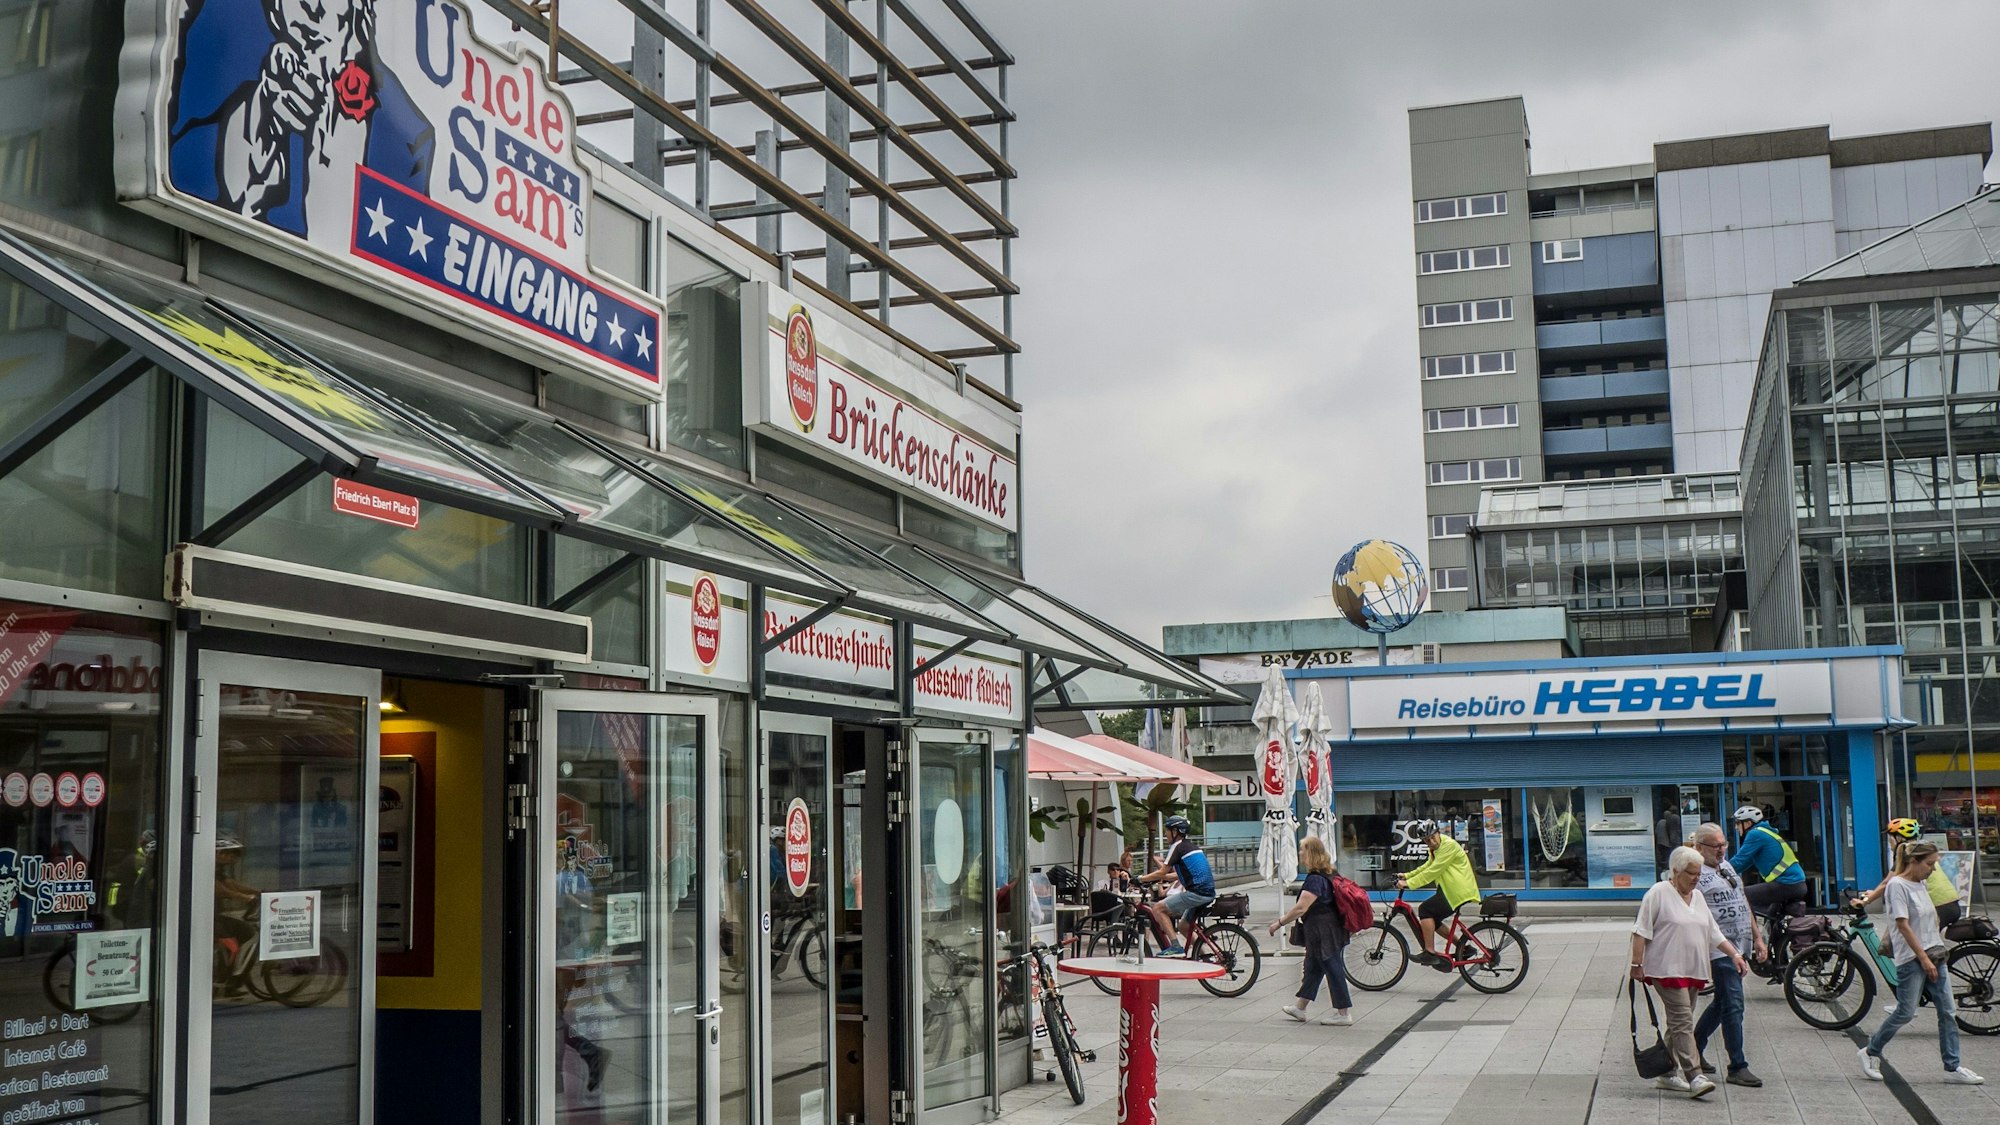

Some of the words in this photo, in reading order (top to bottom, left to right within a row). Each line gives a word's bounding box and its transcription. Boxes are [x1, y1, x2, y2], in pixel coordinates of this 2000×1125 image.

[415, 3, 564, 154] Uncle
[443, 223, 598, 343] EINGANG
[828, 378, 1007, 519] Brückenschänke
[337, 487, 371, 506] Friedrich
[372, 496, 392, 511] Ebert
[393, 501, 410, 516] Platz
[411, 506, 417, 517] 9
[8, 655, 29, 679] Uhr
[27, 629, 52, 656] früh
[916, 655, 973, 702] Reissdorf
[976, 665, 1012, 715] Kölsch
[1399, 695, 1526, 720] Reisebüro
[1533, 673, 1776, 716] HEBBEL
[21, 855, 86, 887] Uncle
[37, 881, 96, 914] Sam's
[34, 924, 52, 932] FOOD,
[53, 923, 75, 931] DRINKS
[97, 952, 130, 961] Benutzung
[100, 940, 128, 948] Toiletten-
[4, 1016, 46, 1038] Billard
[61, 1013, 89, 1031] Dart
[4, 1045, 55, 1067] Internet
[58, 1039, 87, 1059] Café
[0, 1078, 38, 1096] erican
[42, 1065, 109, 1089] Restaurant
[3, 1101, 60, 1125] geöffnet
[62, 1098, 85, 1112] von
